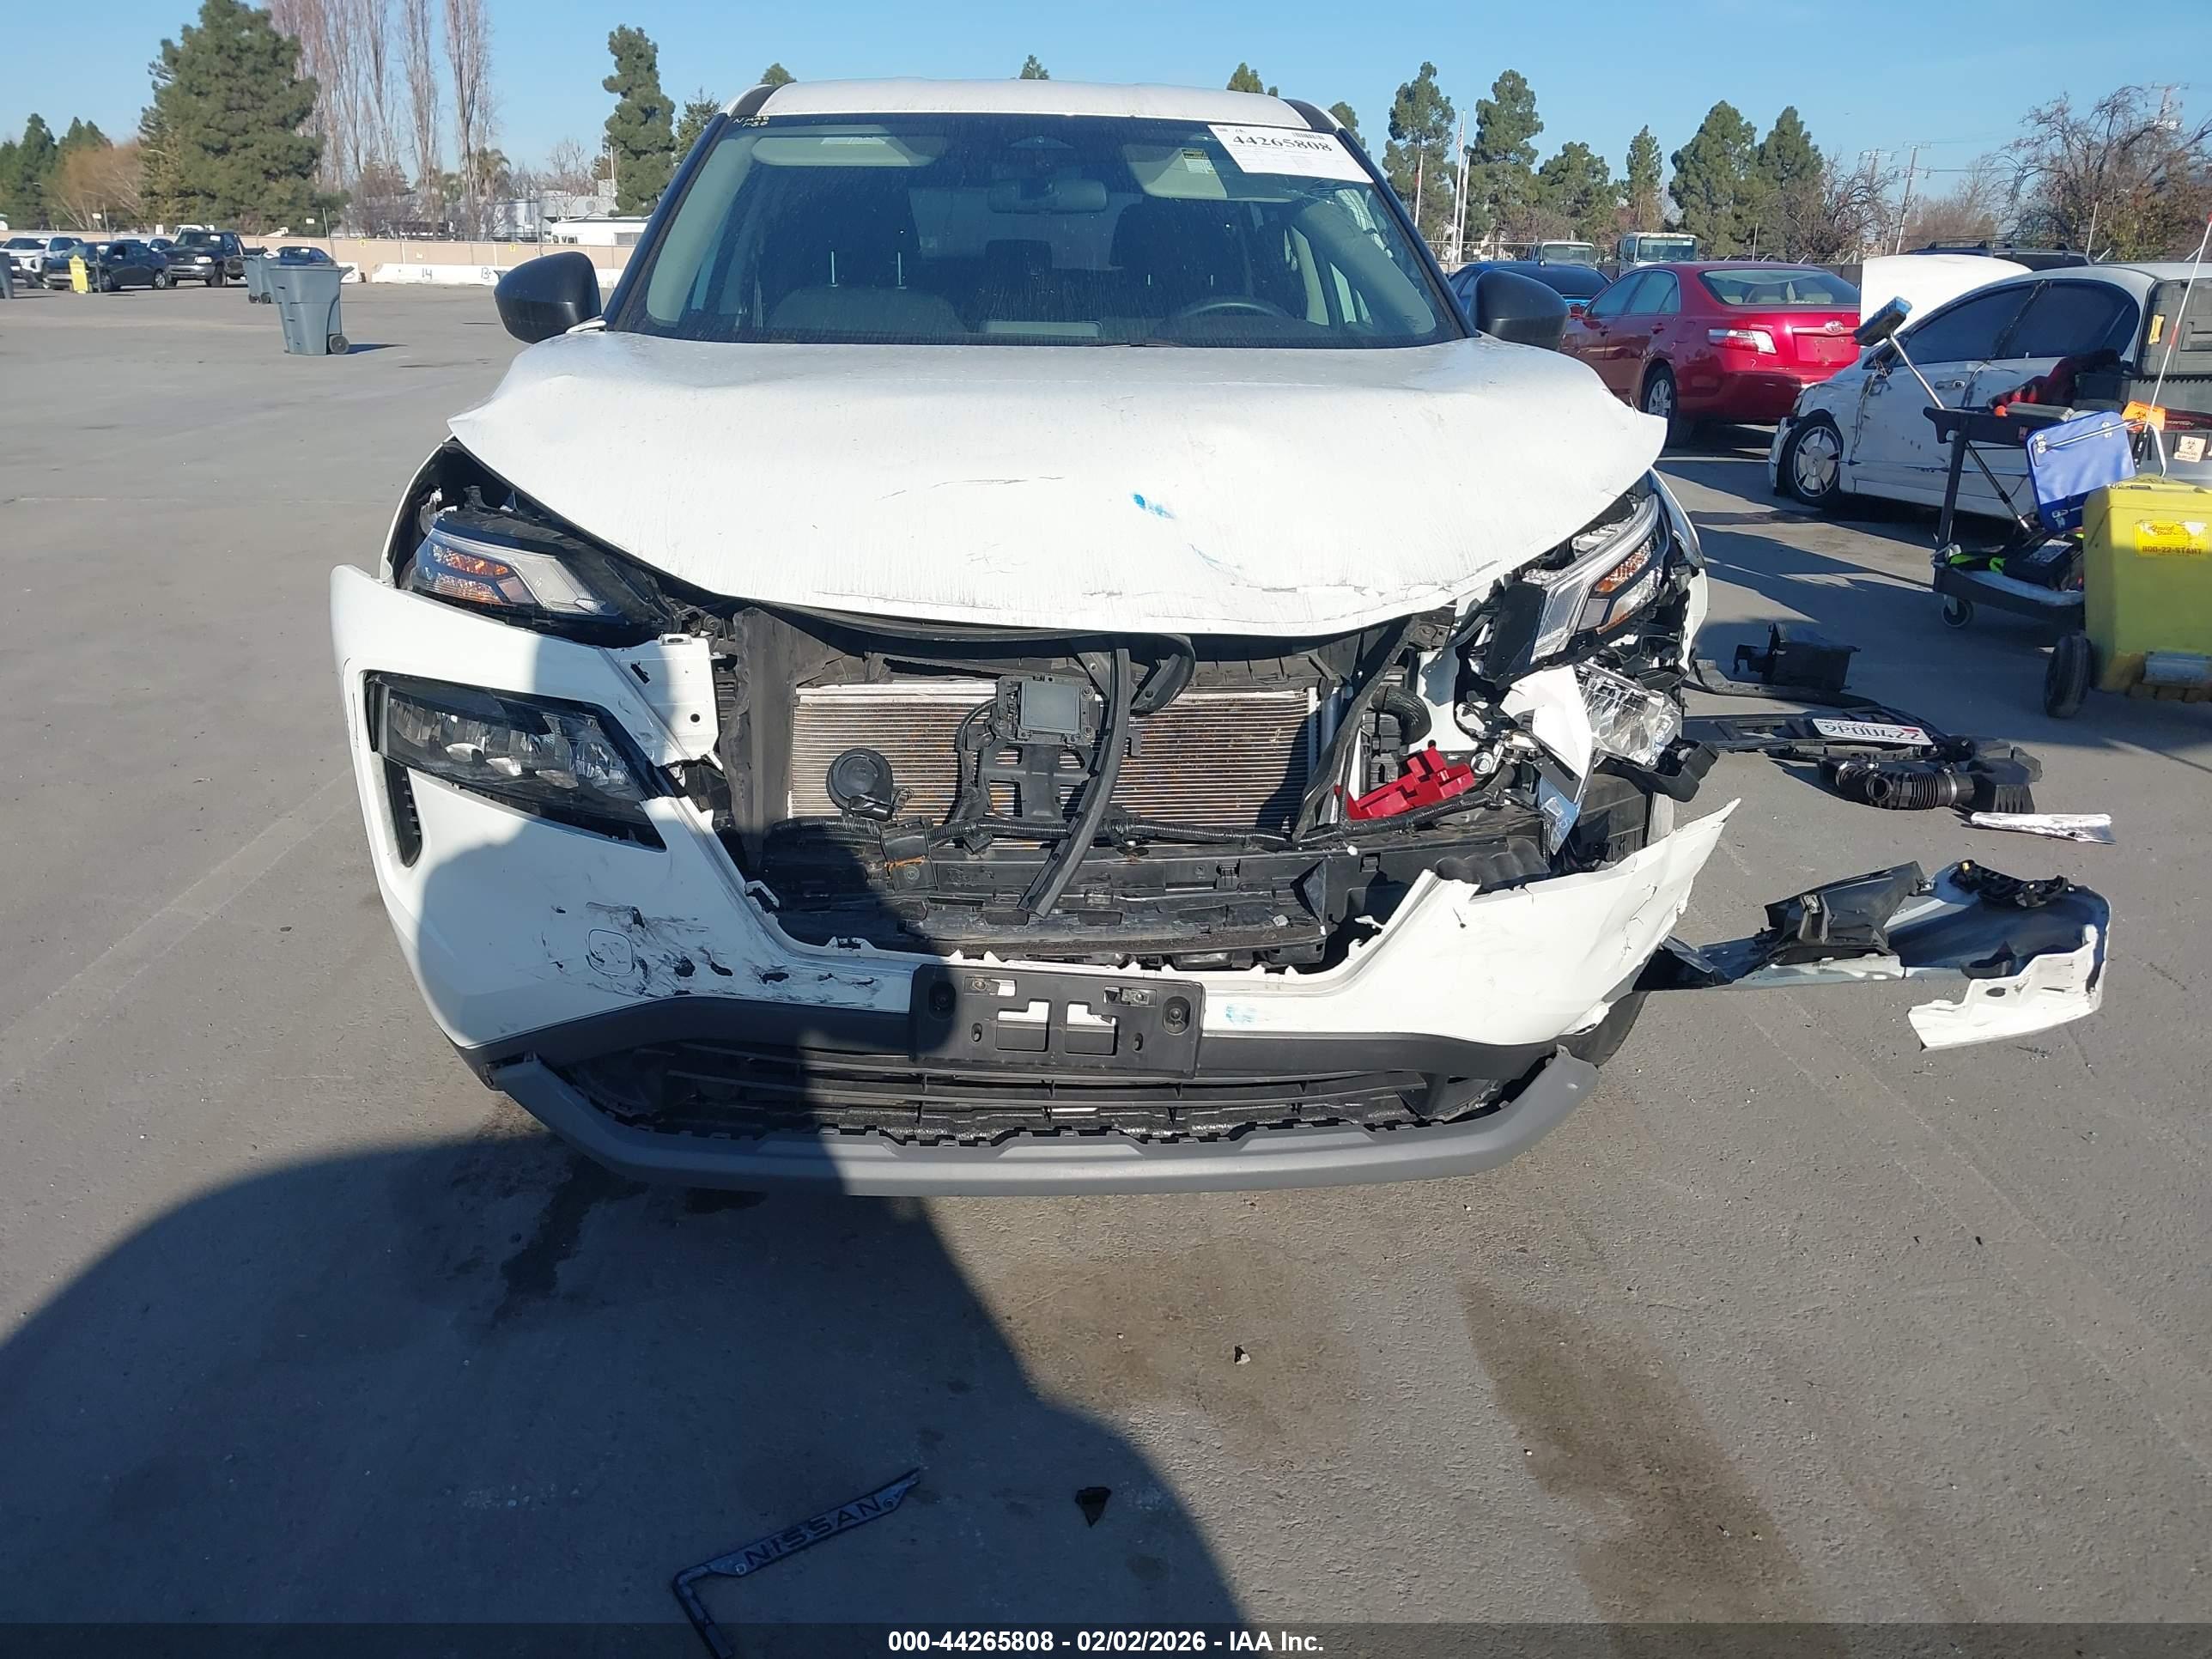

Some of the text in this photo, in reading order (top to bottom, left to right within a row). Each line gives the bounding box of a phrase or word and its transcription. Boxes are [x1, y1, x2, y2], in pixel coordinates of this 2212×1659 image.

[1233, 135, 1333, 152] 44265808
[422, 267, 433, 281] 14
[744, 1497, 882, 1566] NISSAN
